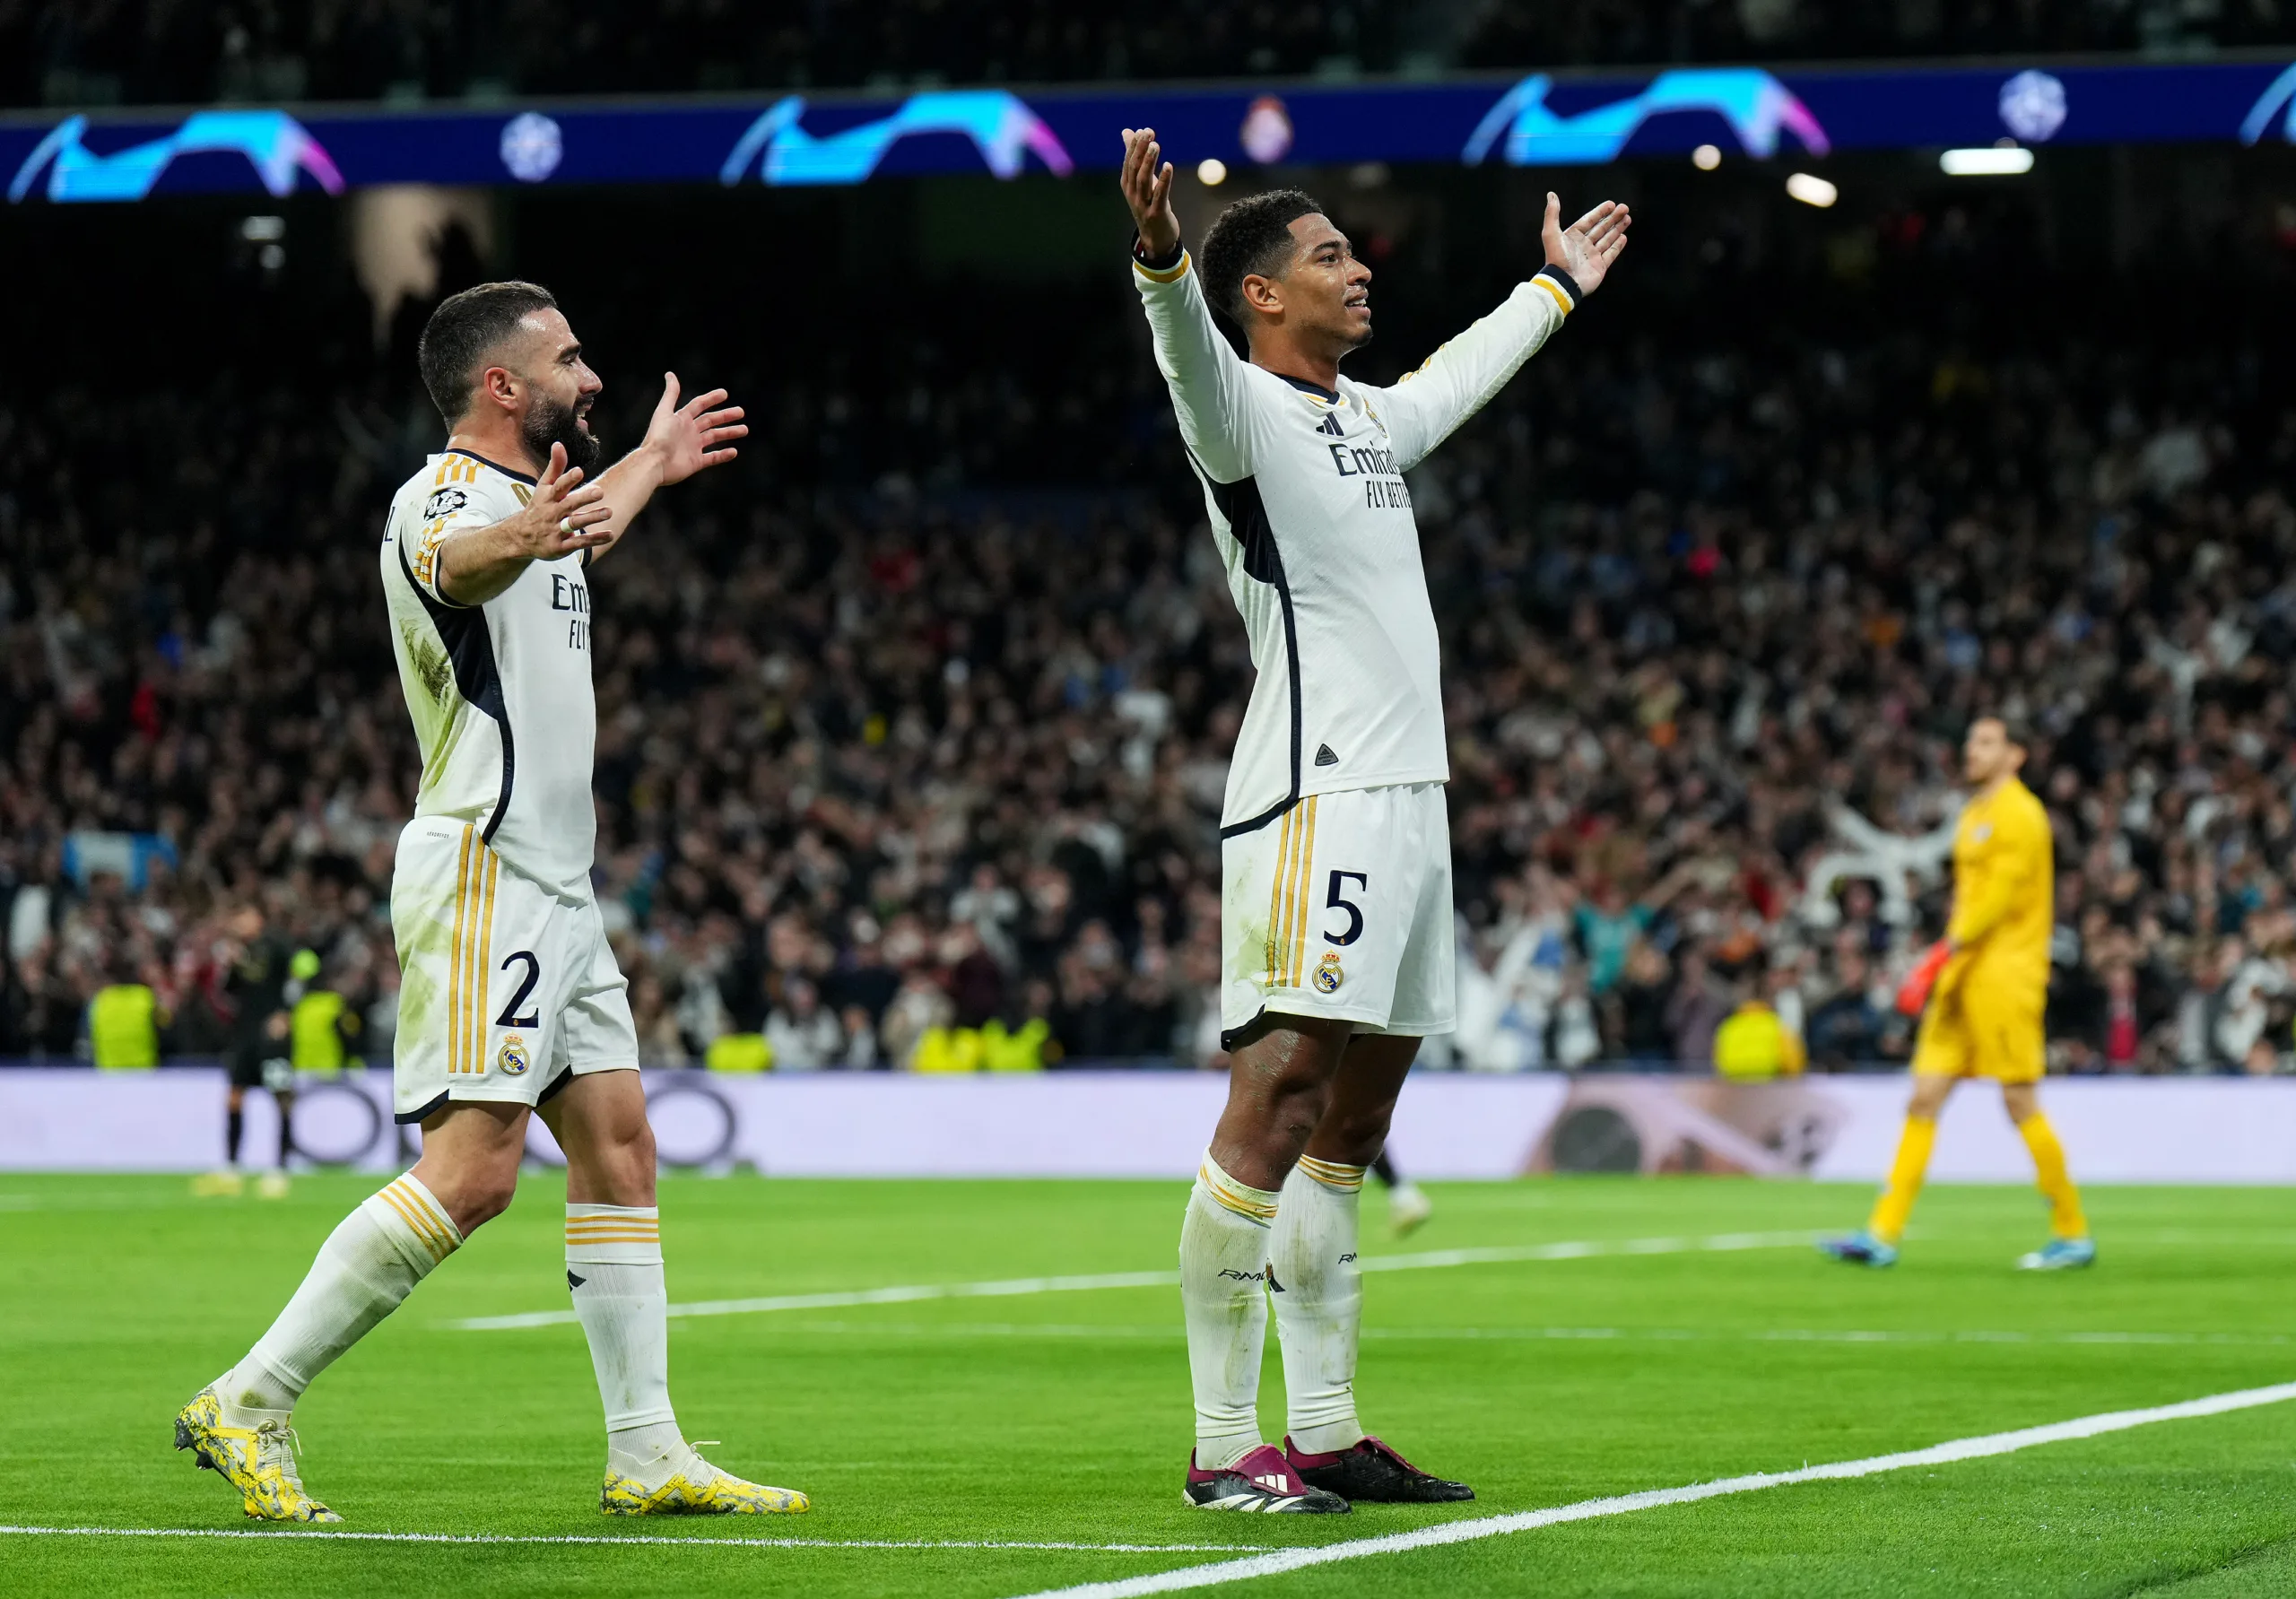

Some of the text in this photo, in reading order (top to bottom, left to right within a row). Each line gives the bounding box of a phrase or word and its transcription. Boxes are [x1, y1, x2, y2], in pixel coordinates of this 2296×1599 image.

[1366, 480, 1386, 508] FLY
[569, 619, 587, 649] FLY
[1323, 869, 1368, 947] 5
[495, 950, 540, 1029] 2
